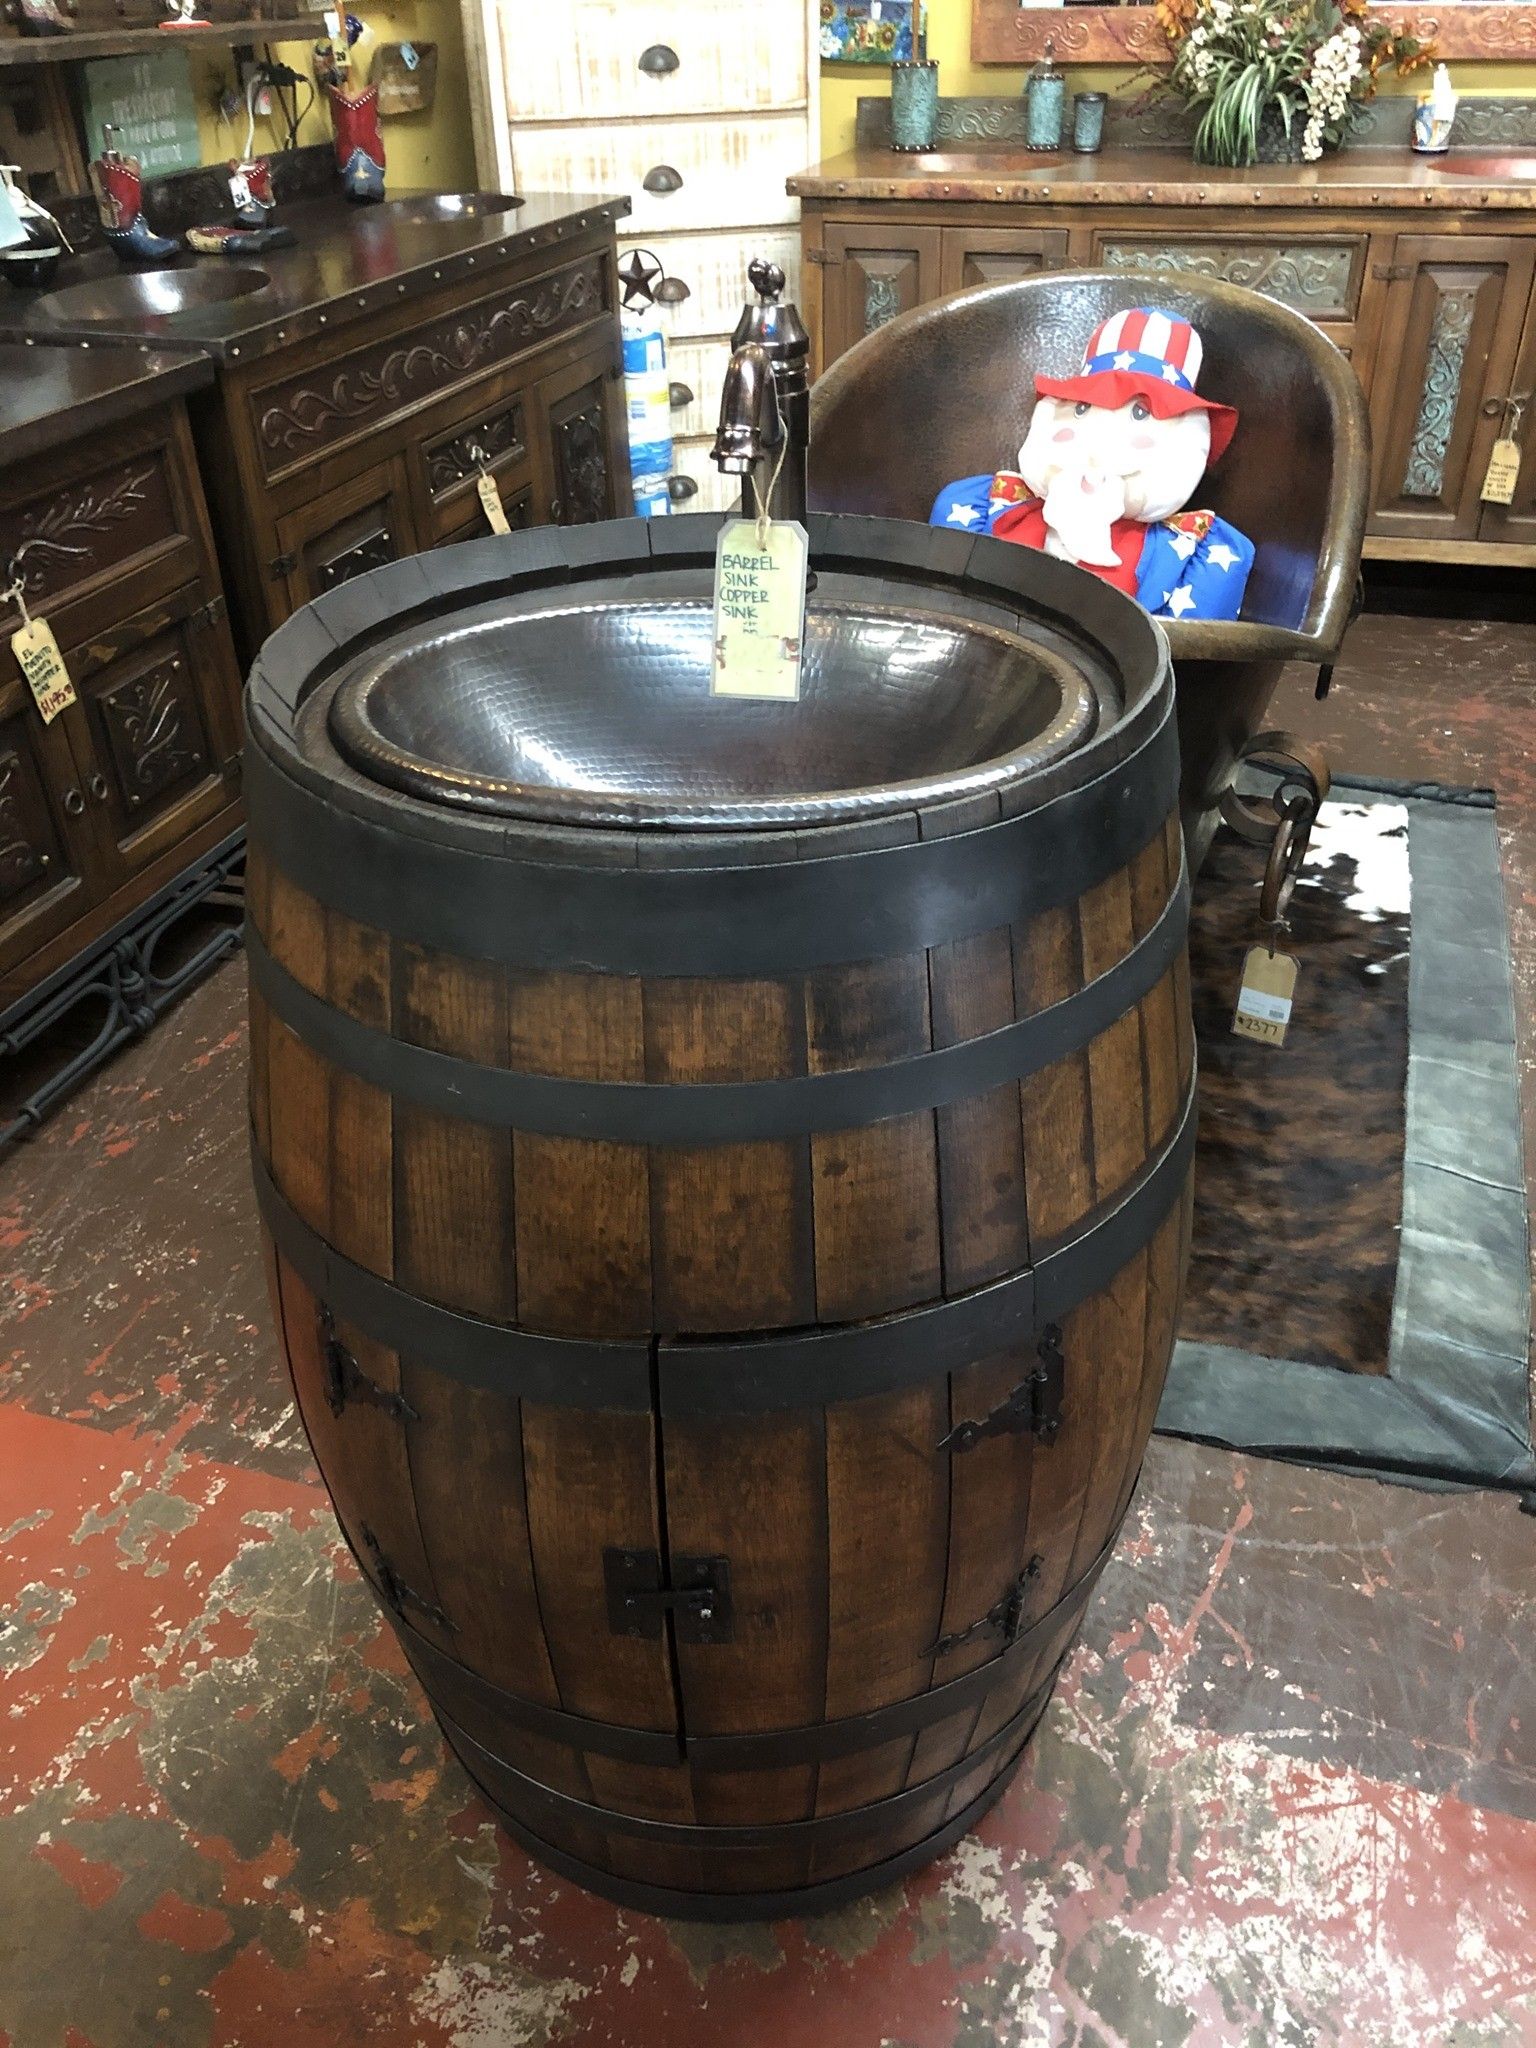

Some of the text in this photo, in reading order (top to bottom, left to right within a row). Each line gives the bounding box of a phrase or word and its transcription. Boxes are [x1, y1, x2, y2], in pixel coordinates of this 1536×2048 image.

[722, 554, 780, 571] BARREL
[725, 572, 759, 587] SINK
[719, 588, 770, 604] COPPER
[722, 605, 759, 620] SINK
